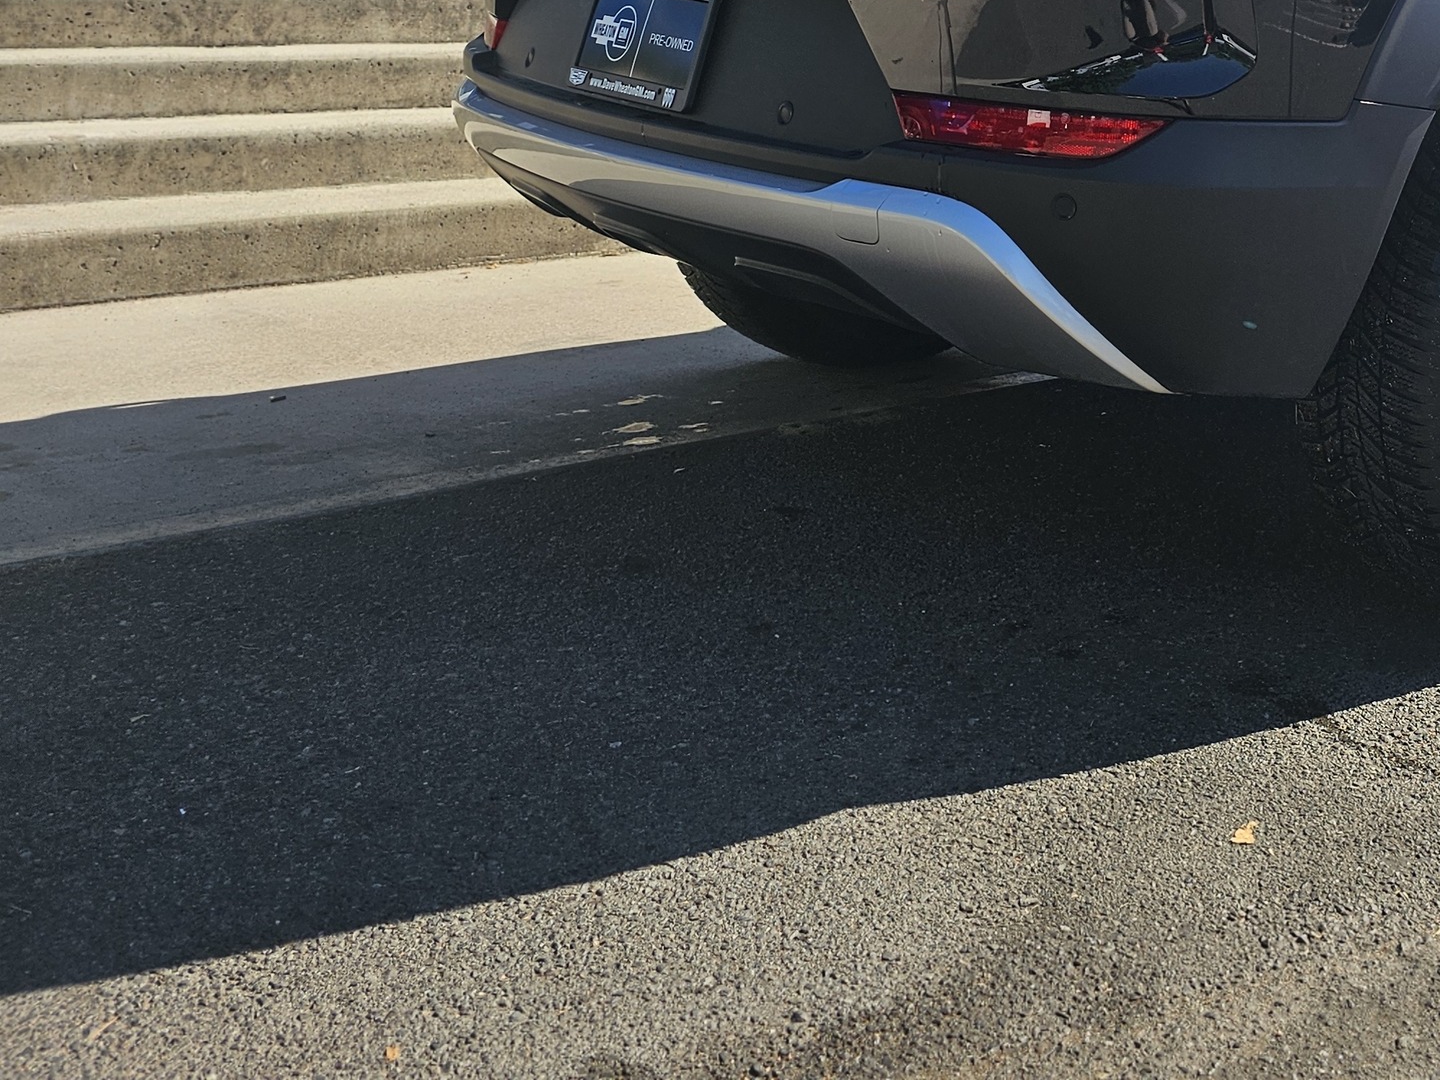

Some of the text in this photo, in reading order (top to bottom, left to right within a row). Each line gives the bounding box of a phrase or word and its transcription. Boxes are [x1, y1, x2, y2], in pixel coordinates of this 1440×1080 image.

[594, 22, 617, 38] WHEATON
[648, 32, 694, 52] PRE-OWNED
[589, 78, 656, 100] www.DaveWheatonGM.com
